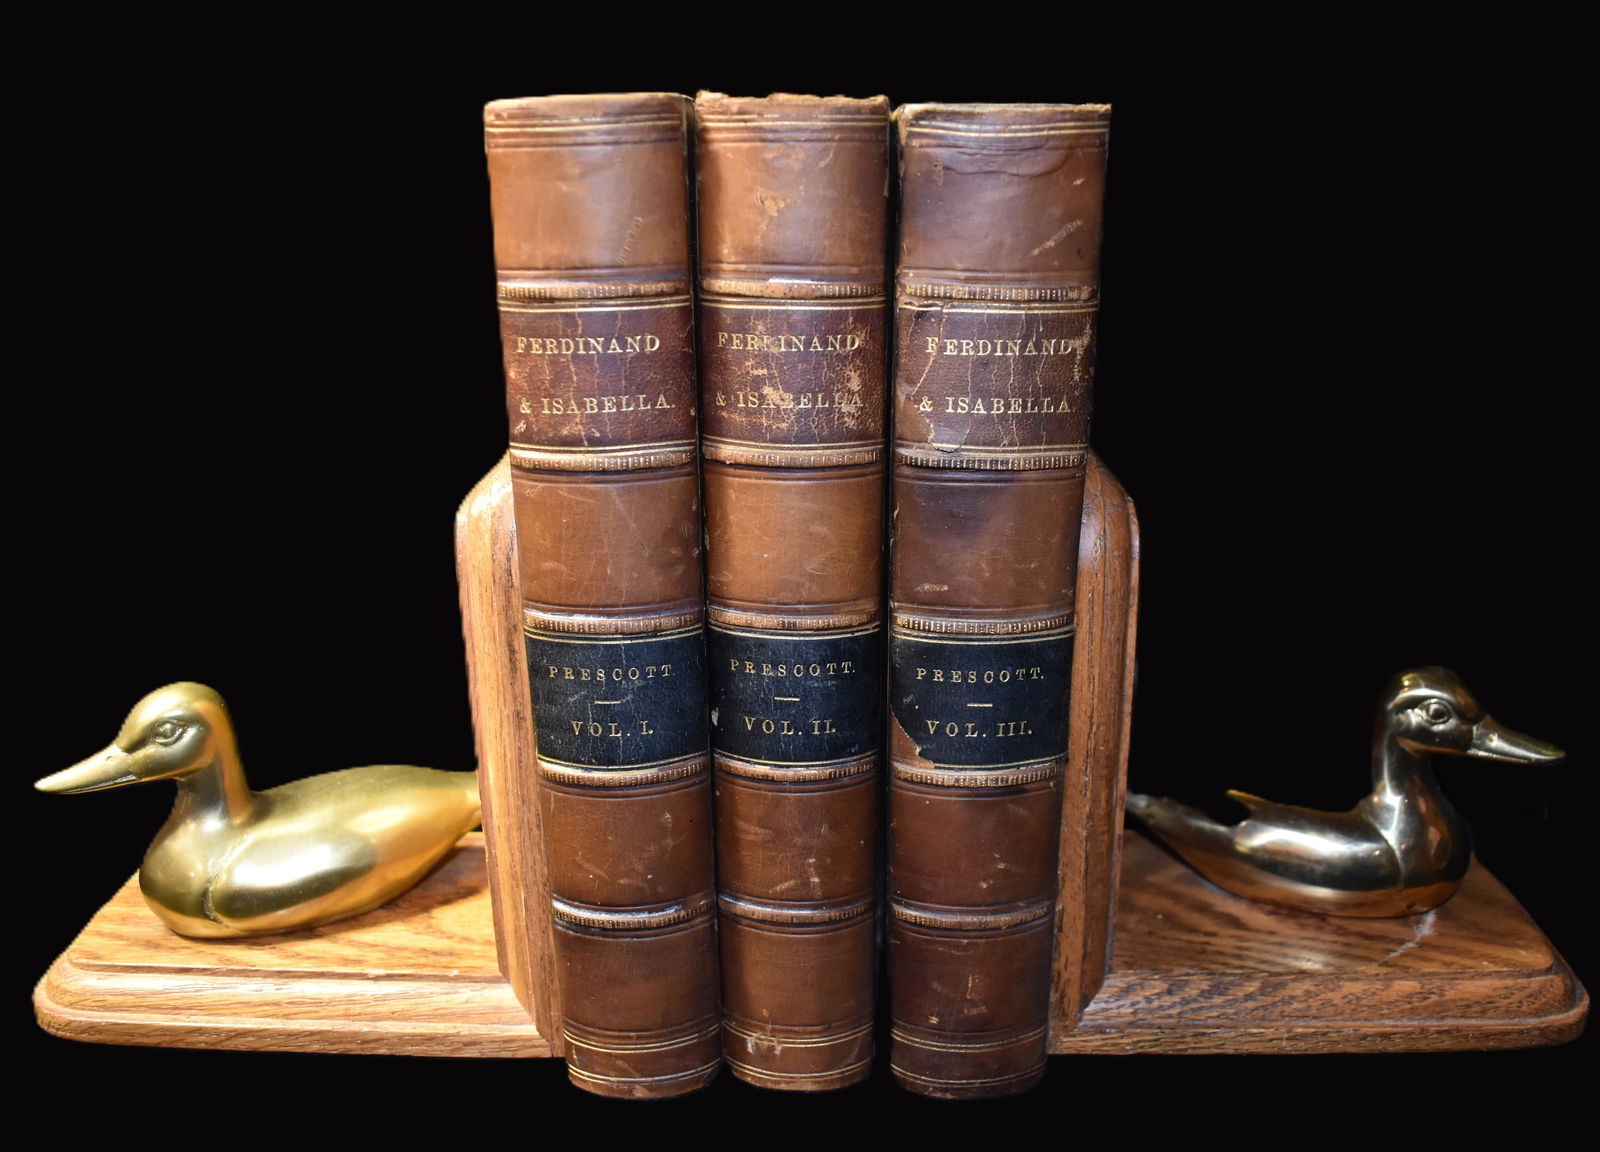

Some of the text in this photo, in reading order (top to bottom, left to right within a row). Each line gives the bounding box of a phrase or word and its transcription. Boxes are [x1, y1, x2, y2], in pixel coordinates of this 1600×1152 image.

[516, 335, 660, 354] FERDINAND
[925, 336, 1072, 356] FERDINAND
[519, 393, 676, 415] & ISABELLA.
[715, 391, 727, 406] &
[919, 395, 933, 411] &
[548, 664, 676, 681] PRESCOTT.
[730, 659, 856, 677] PRESCOTT.
[916, 667, 1044, 684] PRESCOTT.
[570, 720, 654, 737] VOL. I.
[744, 716, 836, 735] VOL. II.
[926, 720, 1032, 738] VOL. III.
